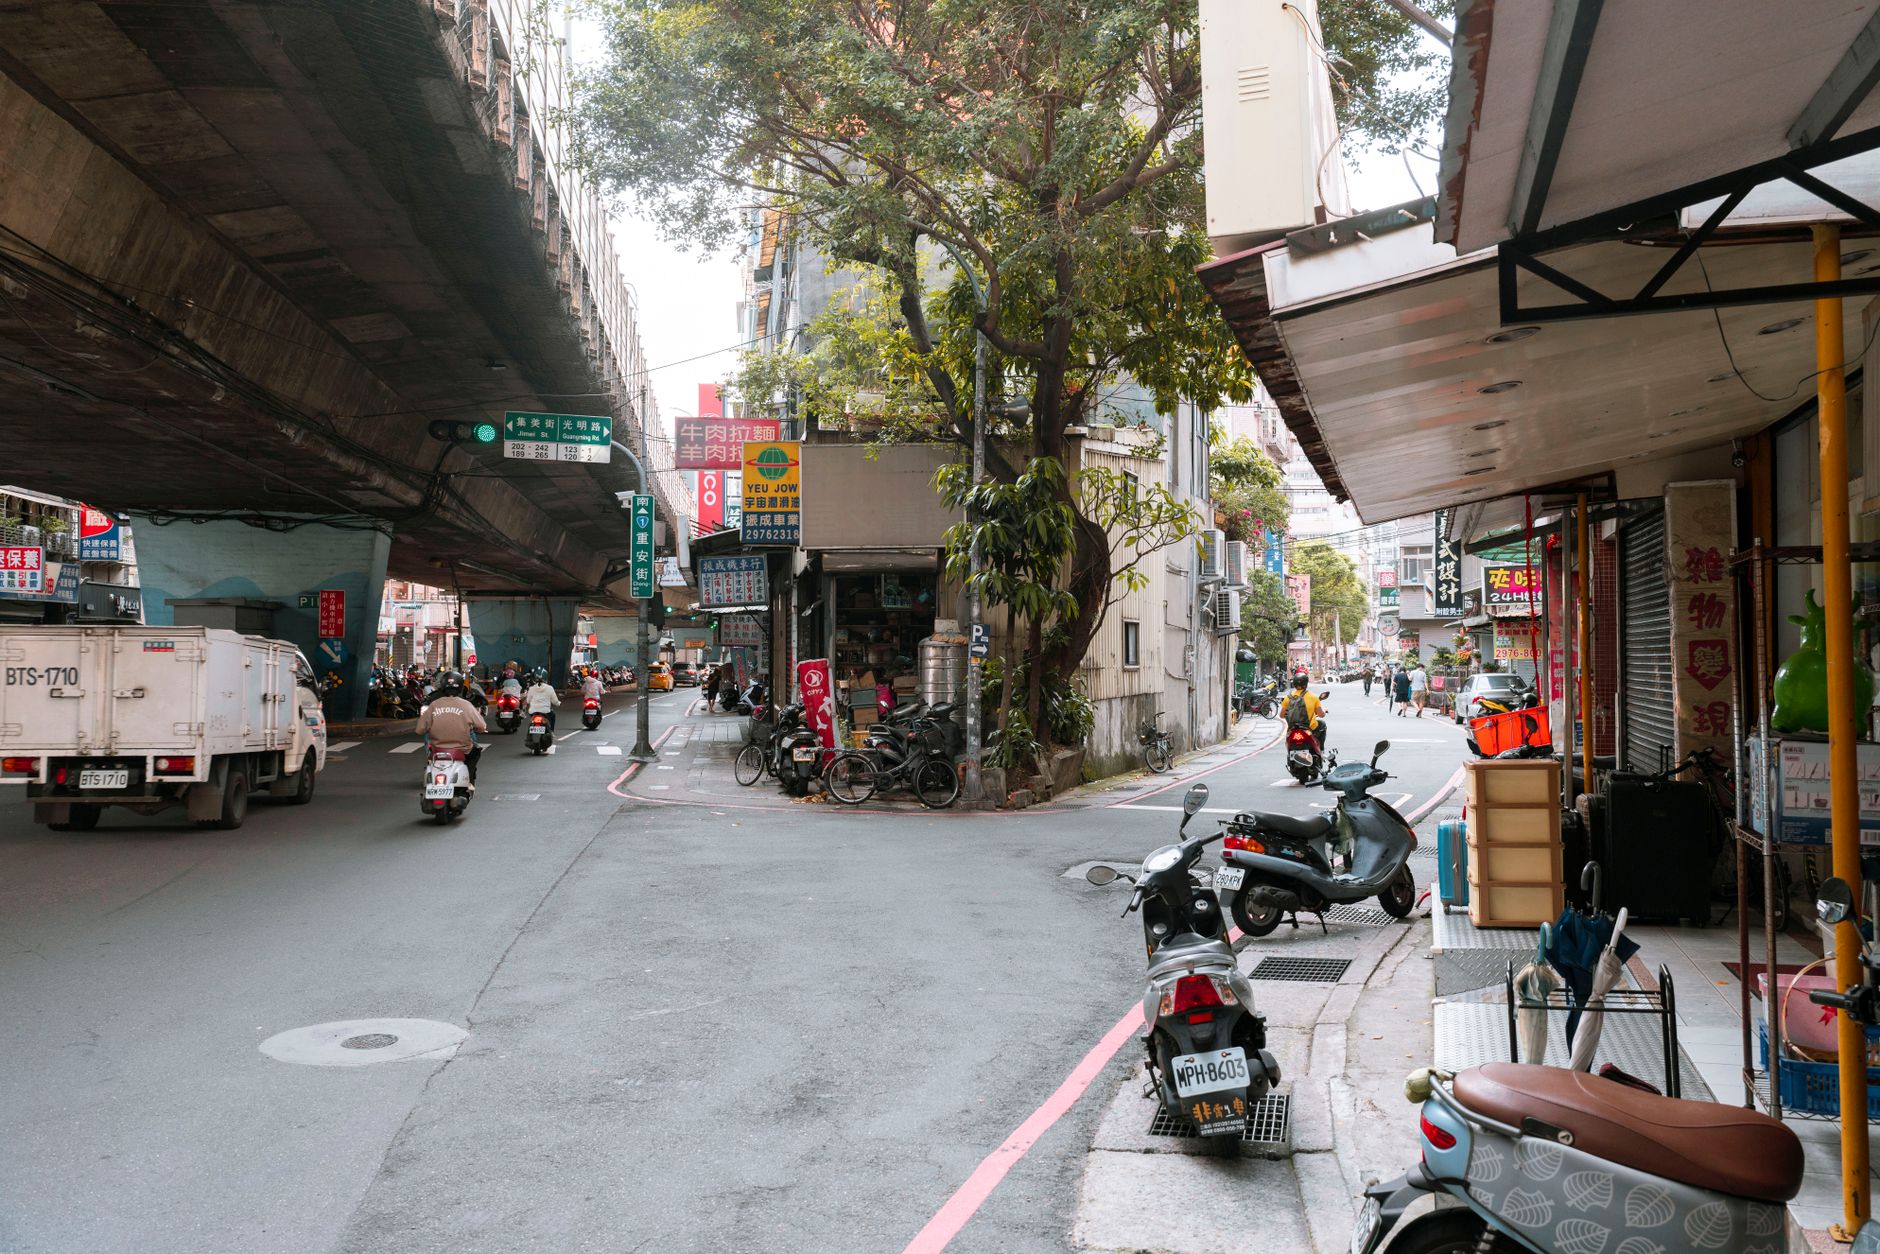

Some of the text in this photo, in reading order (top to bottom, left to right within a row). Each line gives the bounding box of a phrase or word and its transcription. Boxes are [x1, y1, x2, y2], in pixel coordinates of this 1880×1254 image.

[516, 417, 554, 428] 集美街
[563, 420, 601, 431] 光明路
[562, 433, 591, 442] Guangming
[680, 424, 776, 442] 牛肉拉麵
[511, 450, 525, 458] 189
[747, 483, 798, 493] YEU JOW
[636, 497, 649, 507] 南
[745, 496, 800, 509] 宇宙潤滑油
[745, 514, 800, 527] 振成車業
[745, 529, 800, 540] 29762318
[82, 539, 118, 549] 快速保養
[635, 531, 649, 581] 重安街
[972, 625, 983, 643] P
[1685, 546, 1732, 760] 雜物變現
[6, 667, 79, 686] BTS-1710
[81, 774, 127, 786] BTS-1710
[1176, 1058, 1247, 1089] MPH-8603
